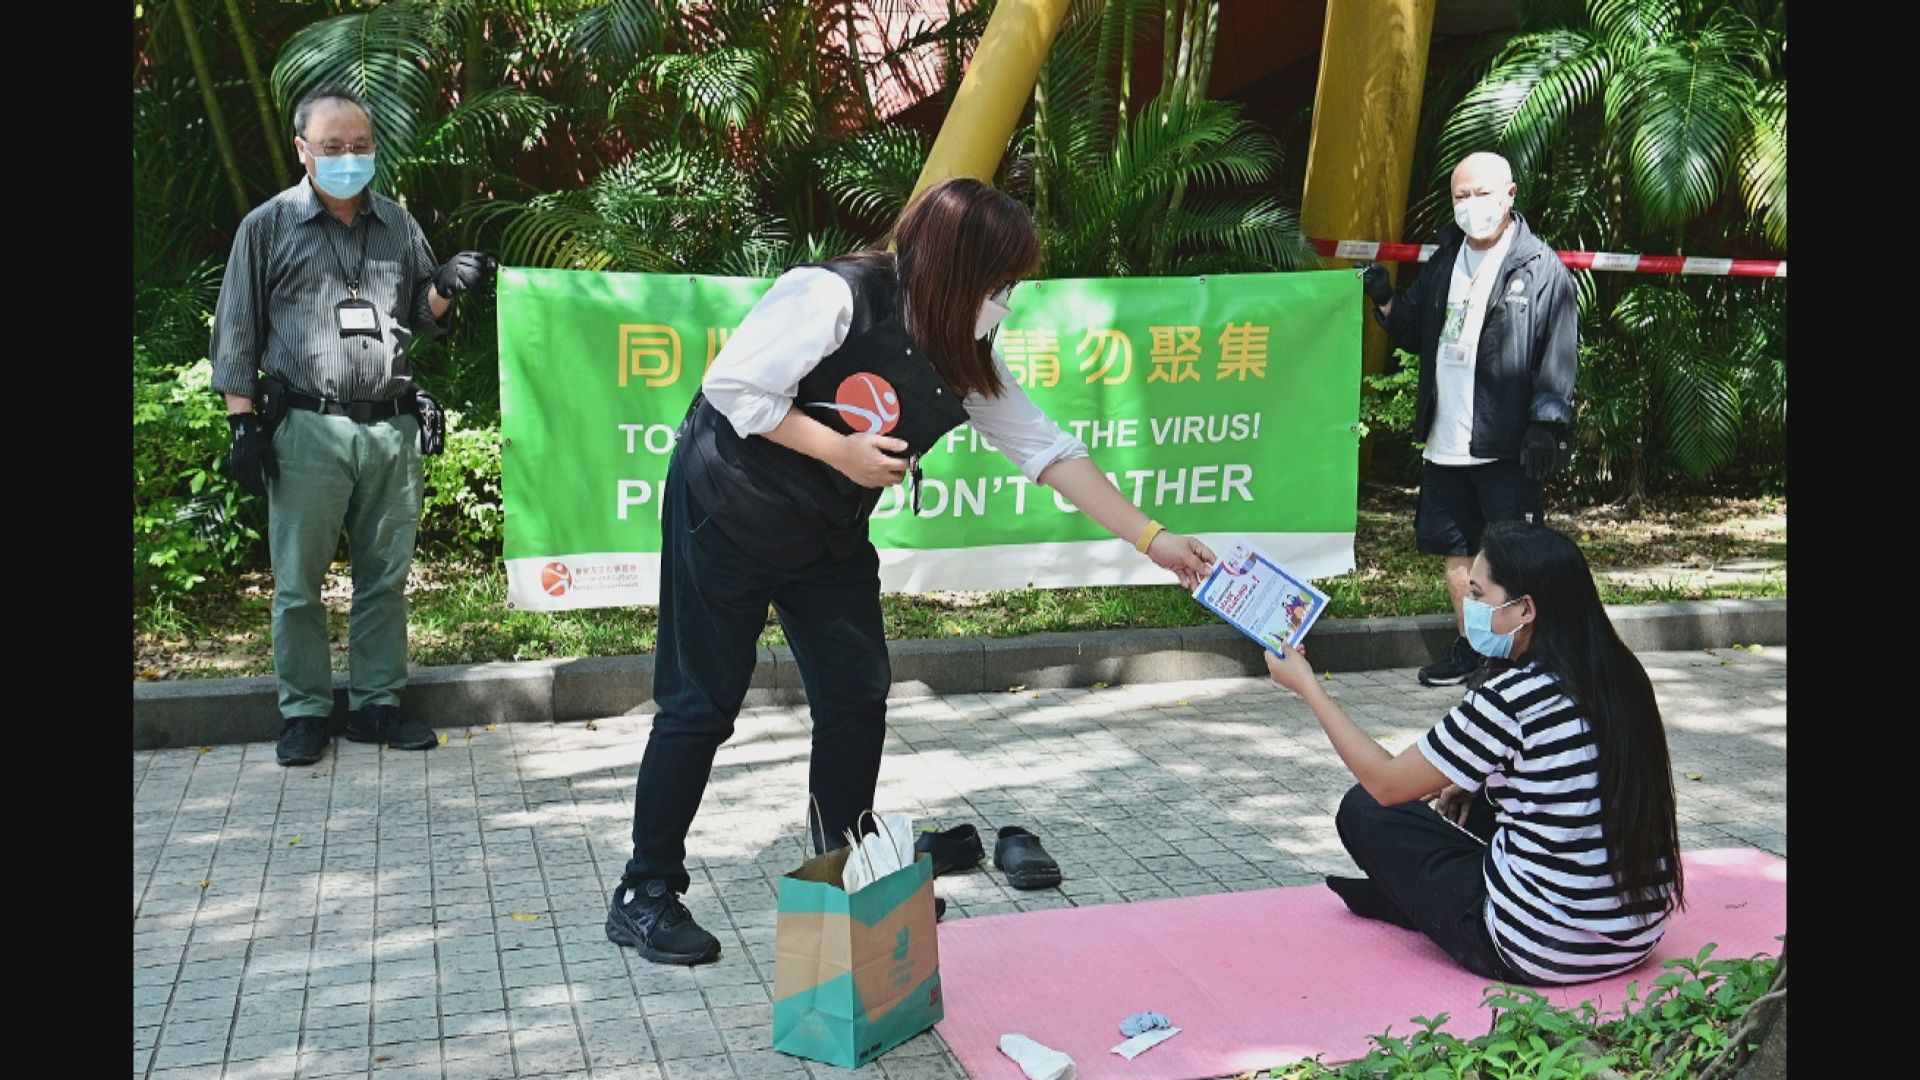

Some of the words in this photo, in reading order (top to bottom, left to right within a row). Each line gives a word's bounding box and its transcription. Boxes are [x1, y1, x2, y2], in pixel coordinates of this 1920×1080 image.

[1001, 322, 1270, 389] 請勿聚集
[1069, 418, 1139, 449] THE
[1150, 411, 1261, 446] VIRUS!
